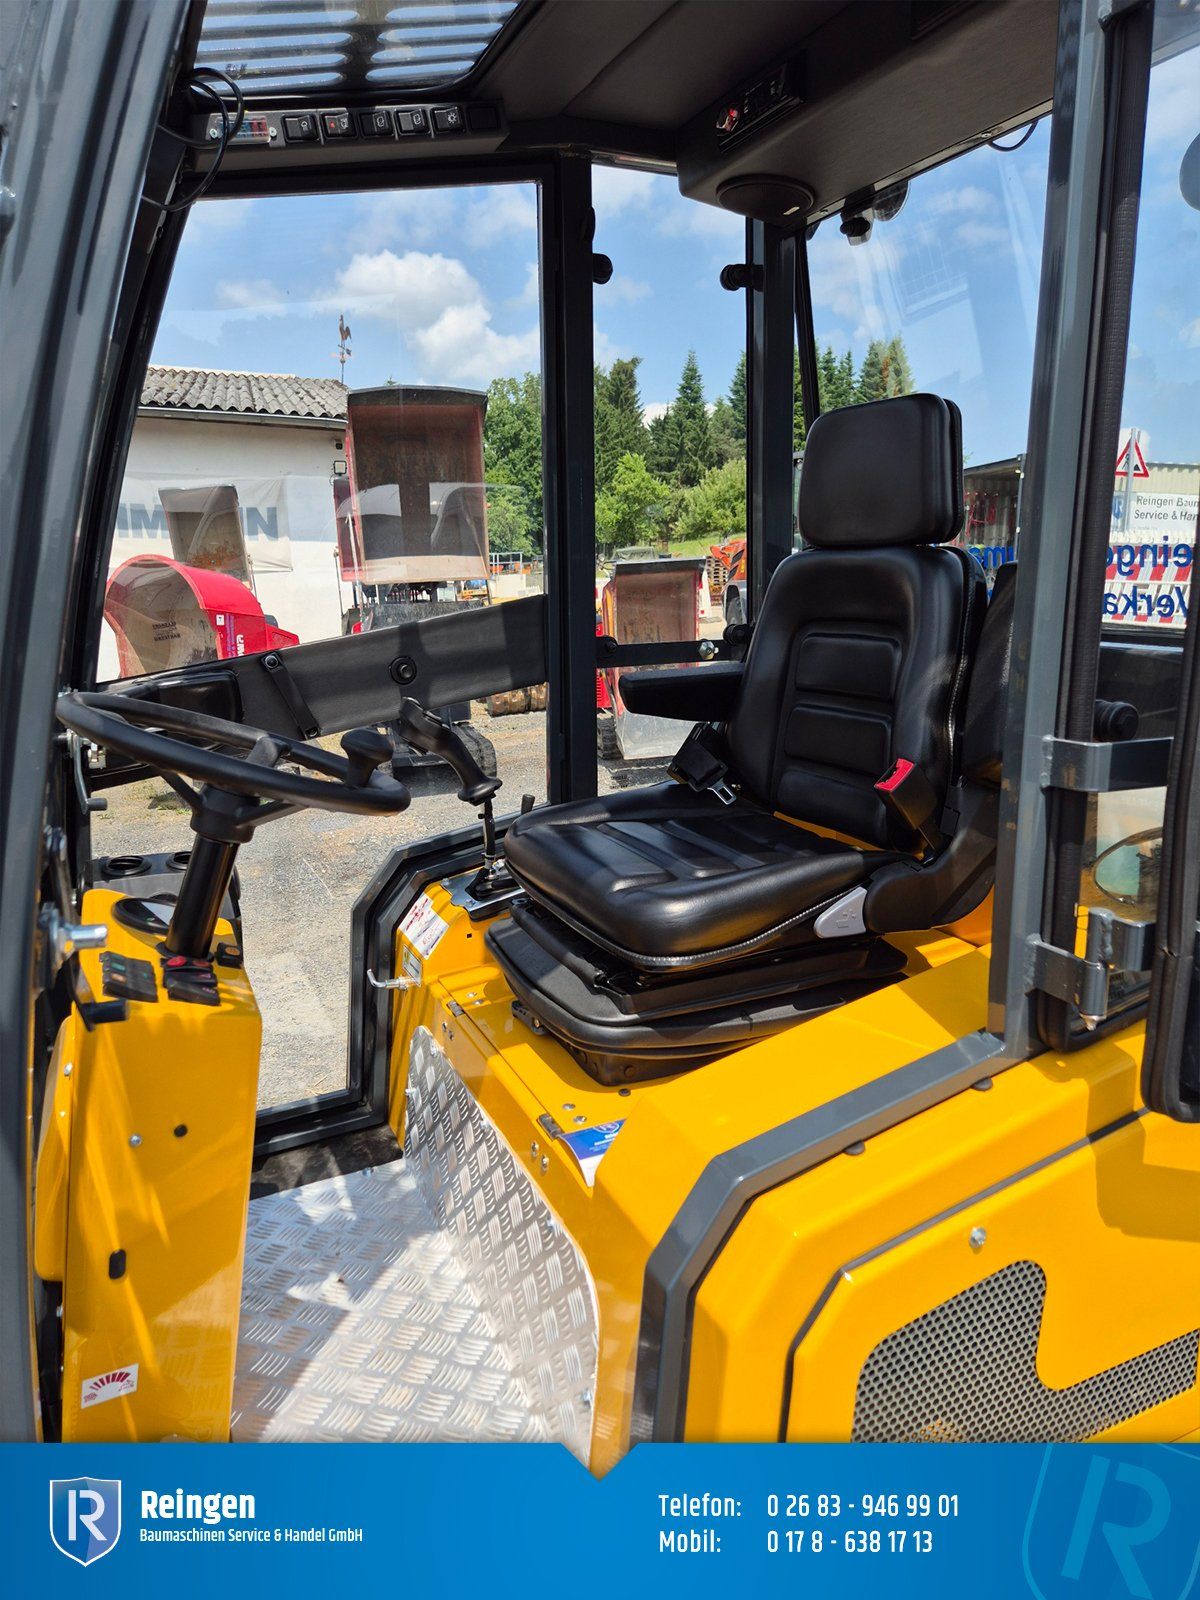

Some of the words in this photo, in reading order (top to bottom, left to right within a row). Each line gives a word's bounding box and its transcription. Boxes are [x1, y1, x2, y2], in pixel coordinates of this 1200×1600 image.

[1136, 496, 1174, 509] Reingen
[1134, 509, 1169, 520] Service
[1171, 510, 1178, 520] &
